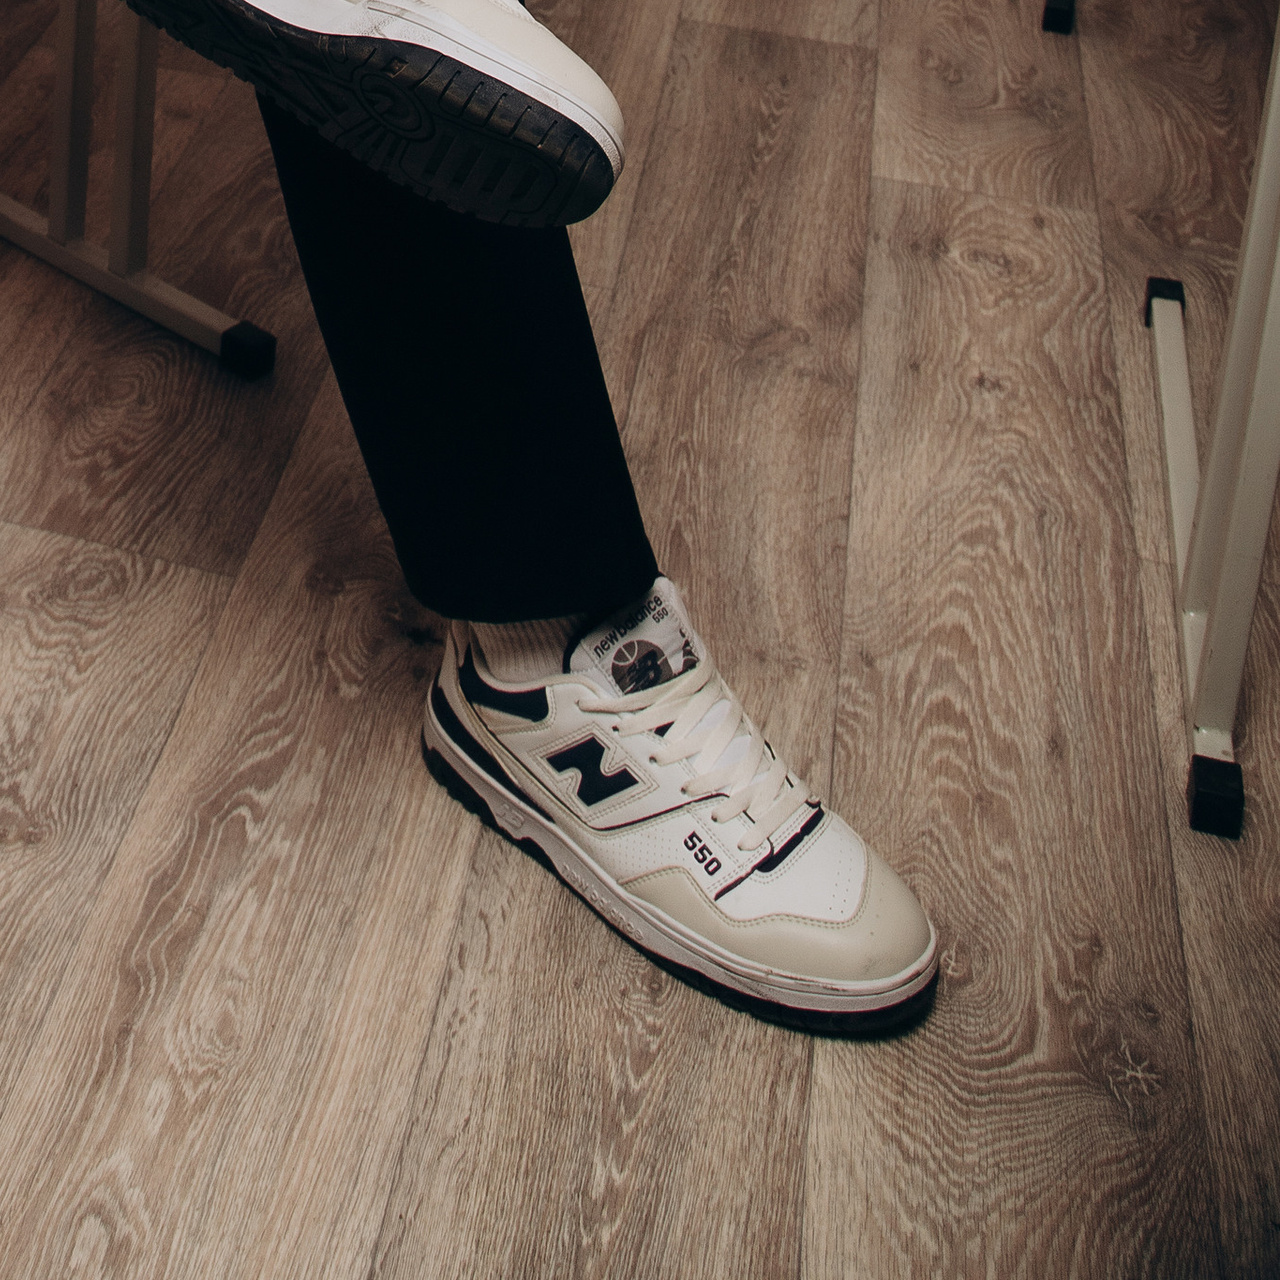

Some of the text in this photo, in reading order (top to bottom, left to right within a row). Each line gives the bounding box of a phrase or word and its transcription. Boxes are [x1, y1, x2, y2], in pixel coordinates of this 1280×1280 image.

[593, 594, 663, 658] new balance
[652, 606, 669, 624] 550
[683, 831, 721, 877] 550
